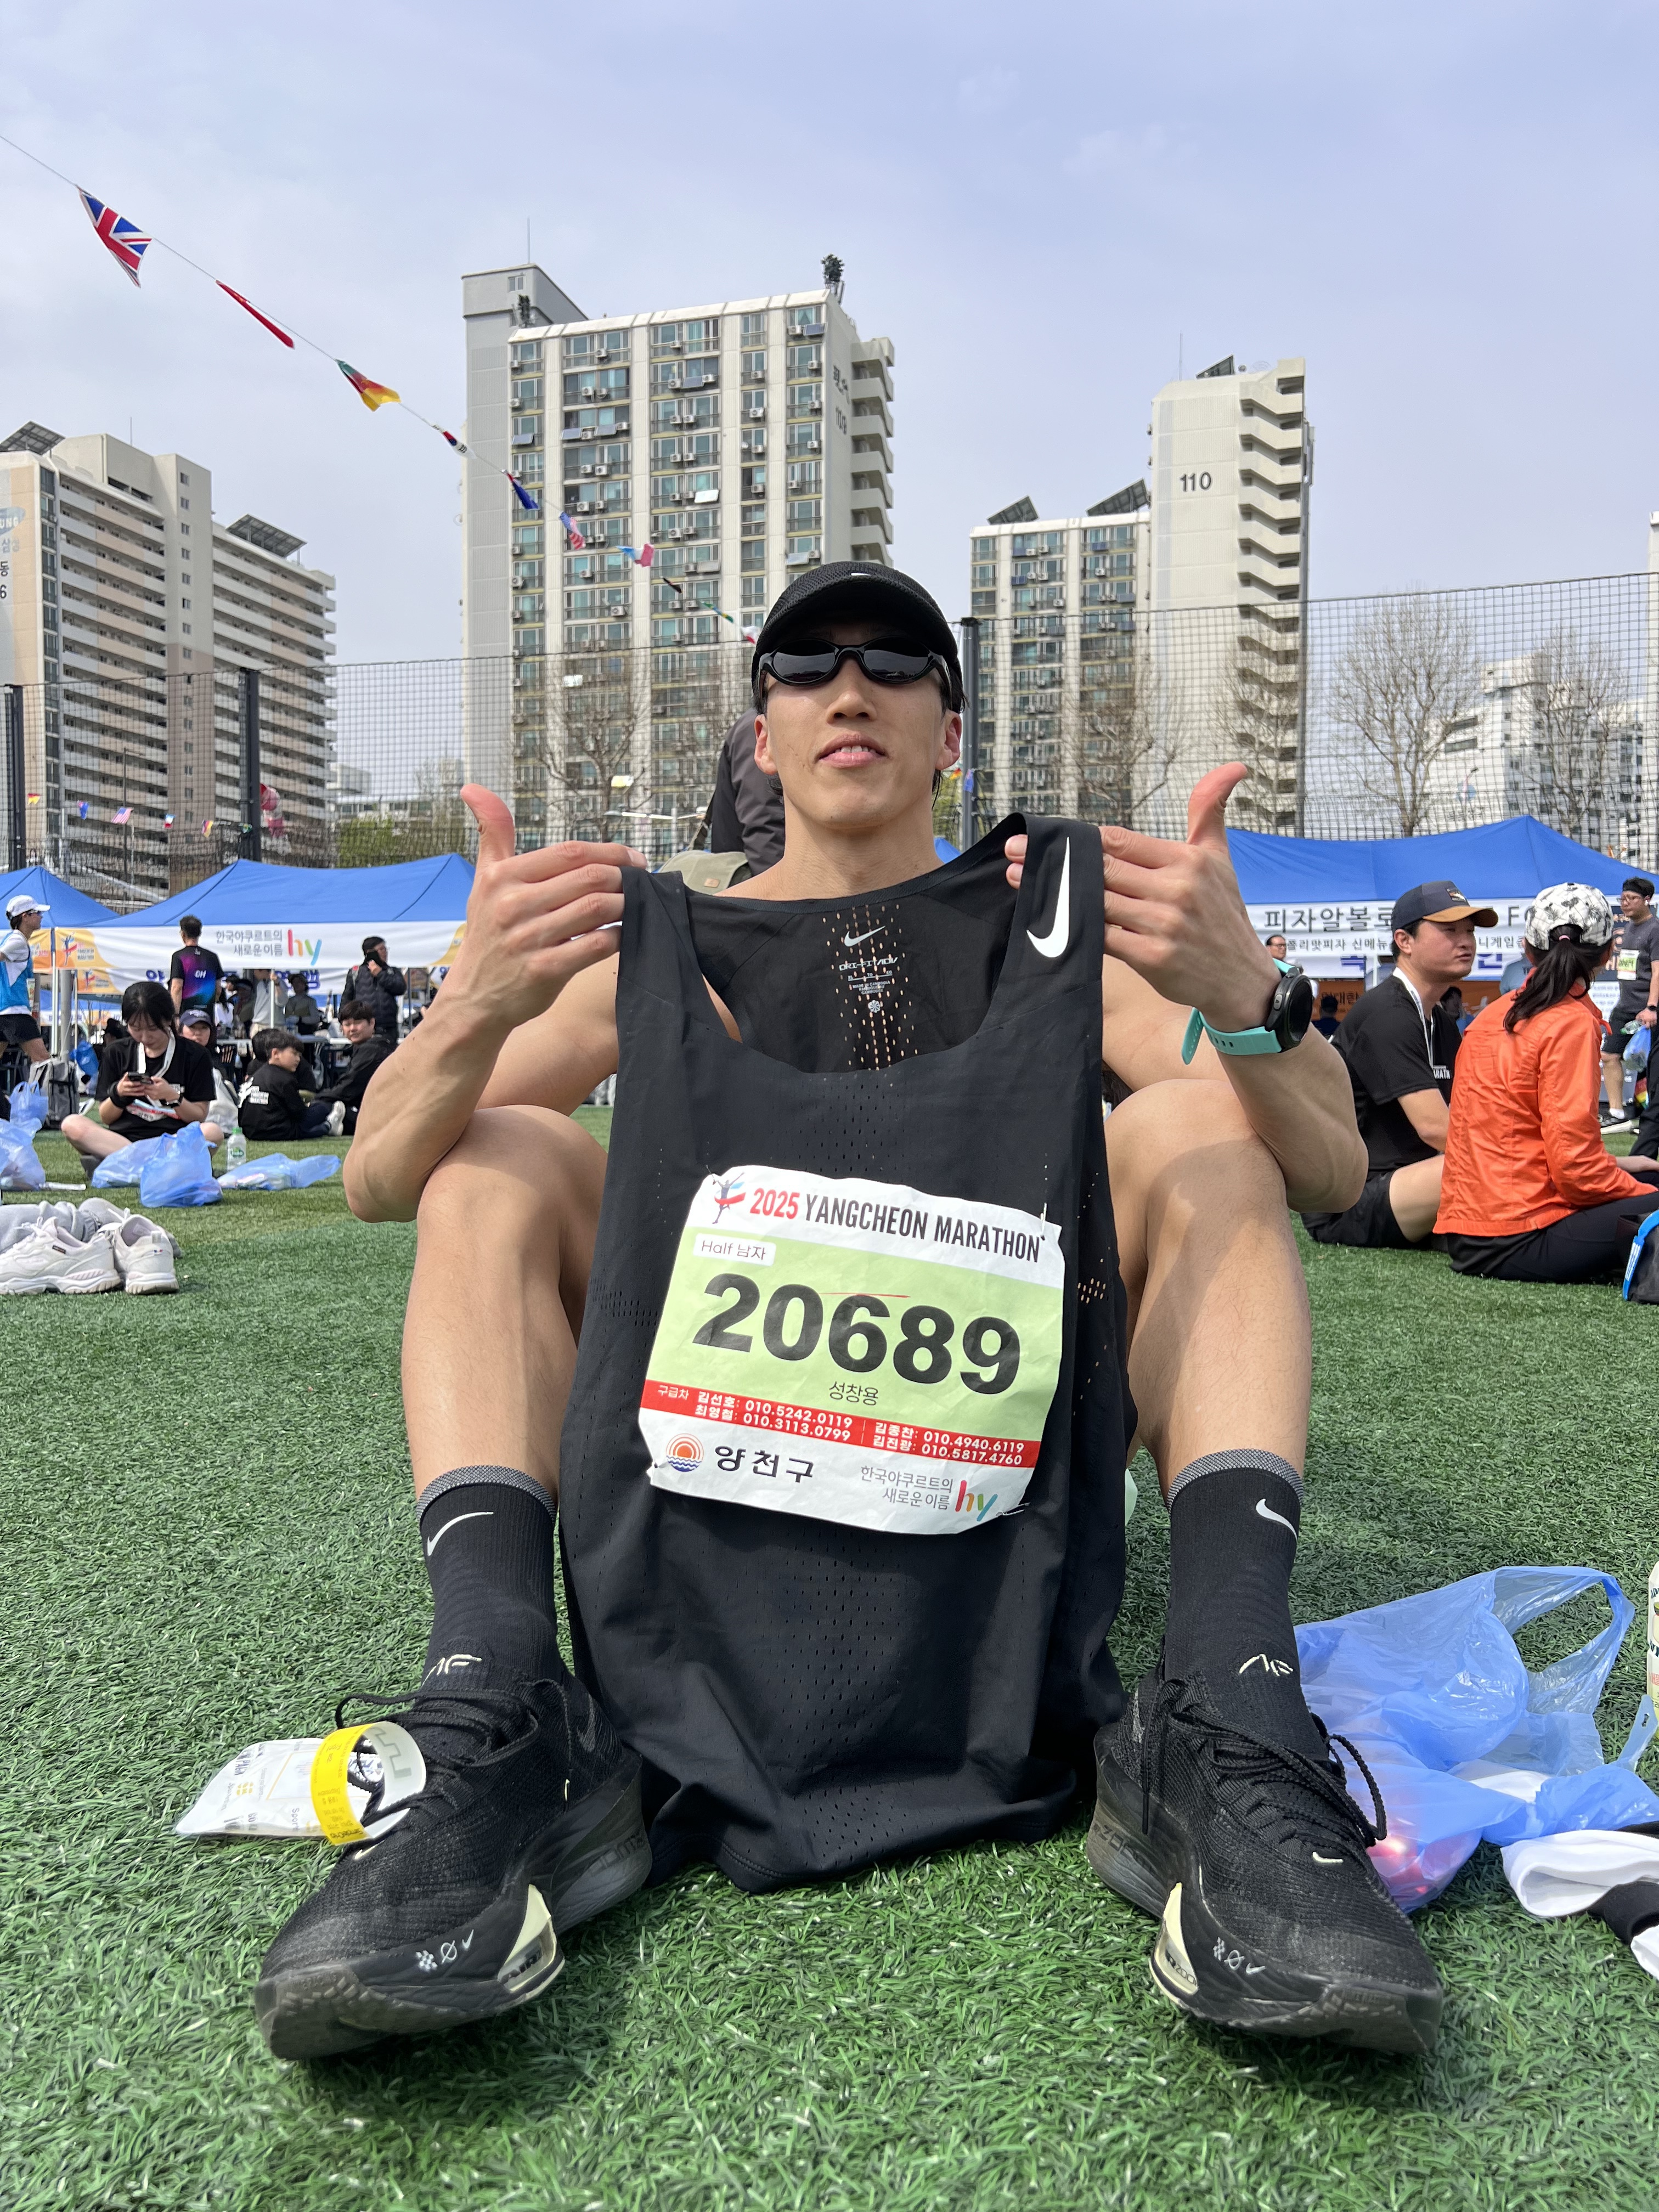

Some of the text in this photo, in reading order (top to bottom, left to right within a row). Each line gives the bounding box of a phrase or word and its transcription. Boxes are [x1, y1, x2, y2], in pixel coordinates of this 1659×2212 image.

[1179, 472, 1212, 492] 110
[216, 929, 283, 944] 한국야쿠르트의
[288, 929, 322, 966] hy
[234, 943, 283, 957] 새로운 이름
[750, 1188, 1040, 1263] 2025 YANGCHEON MARATHON
[701, 1240, 766, 1260] Half 남자
[692, 1273, 1021, 1395] 20689
[658, 1384, 689, 1401] 구급차
[745, 1400, 853, 1428] 010.5242.0119
[829, 1381, 879, 1406] 성창용
[743, 1413, 851, 1441] 010.3113.0799
[921, 1443, 1022, 1465] 010.5817.4760
[923, 1431, 1025, 1453] 010.4940.6119
[715, 1445, 815, 1483] 양천구
[861, 1465, 953, 1493] 한국야쿠르트의
[882, 1487, 950, 1510] 새로운 이름
[955, 1480, 998, 1522] hy
